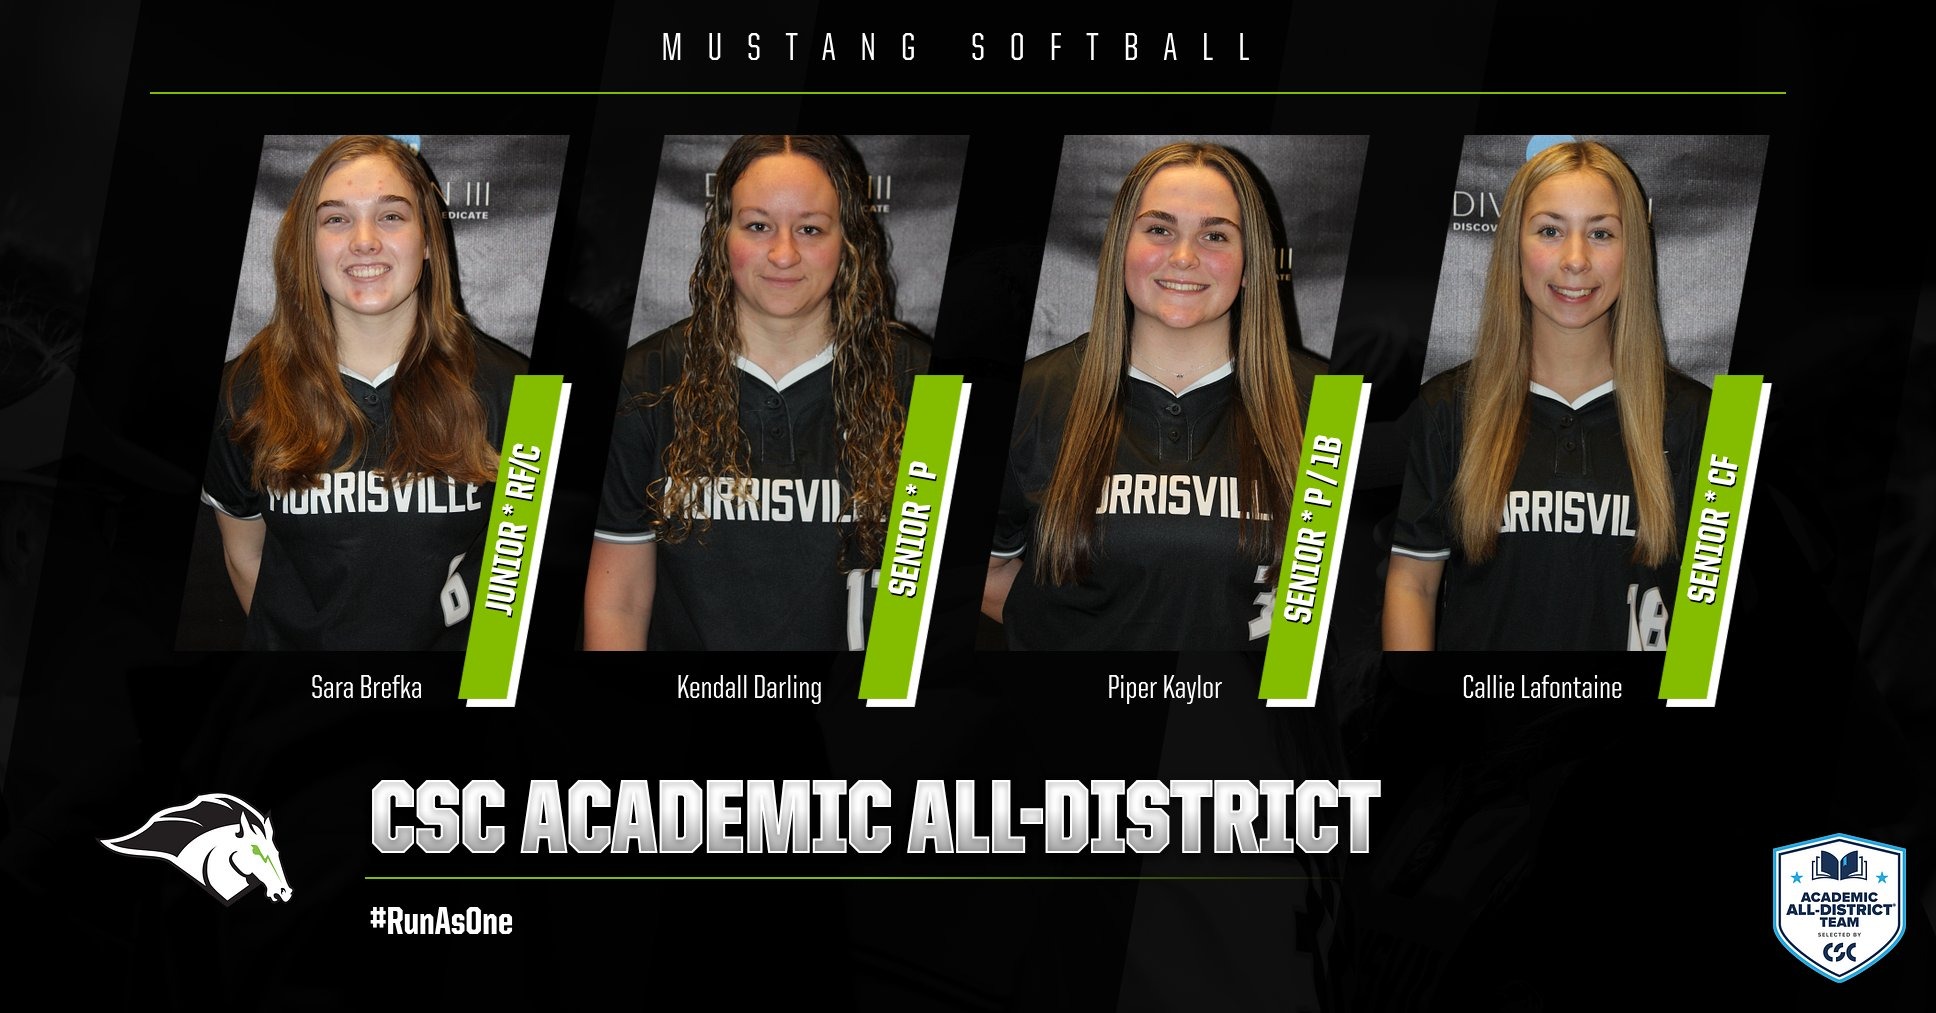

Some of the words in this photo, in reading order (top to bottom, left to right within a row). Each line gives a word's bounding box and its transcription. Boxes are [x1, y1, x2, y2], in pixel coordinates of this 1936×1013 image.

[442, 211, 489, 220] EDICATE
[1453, 222, 1498, 232] DISCOV
[440, 552, 471, 628] 6
